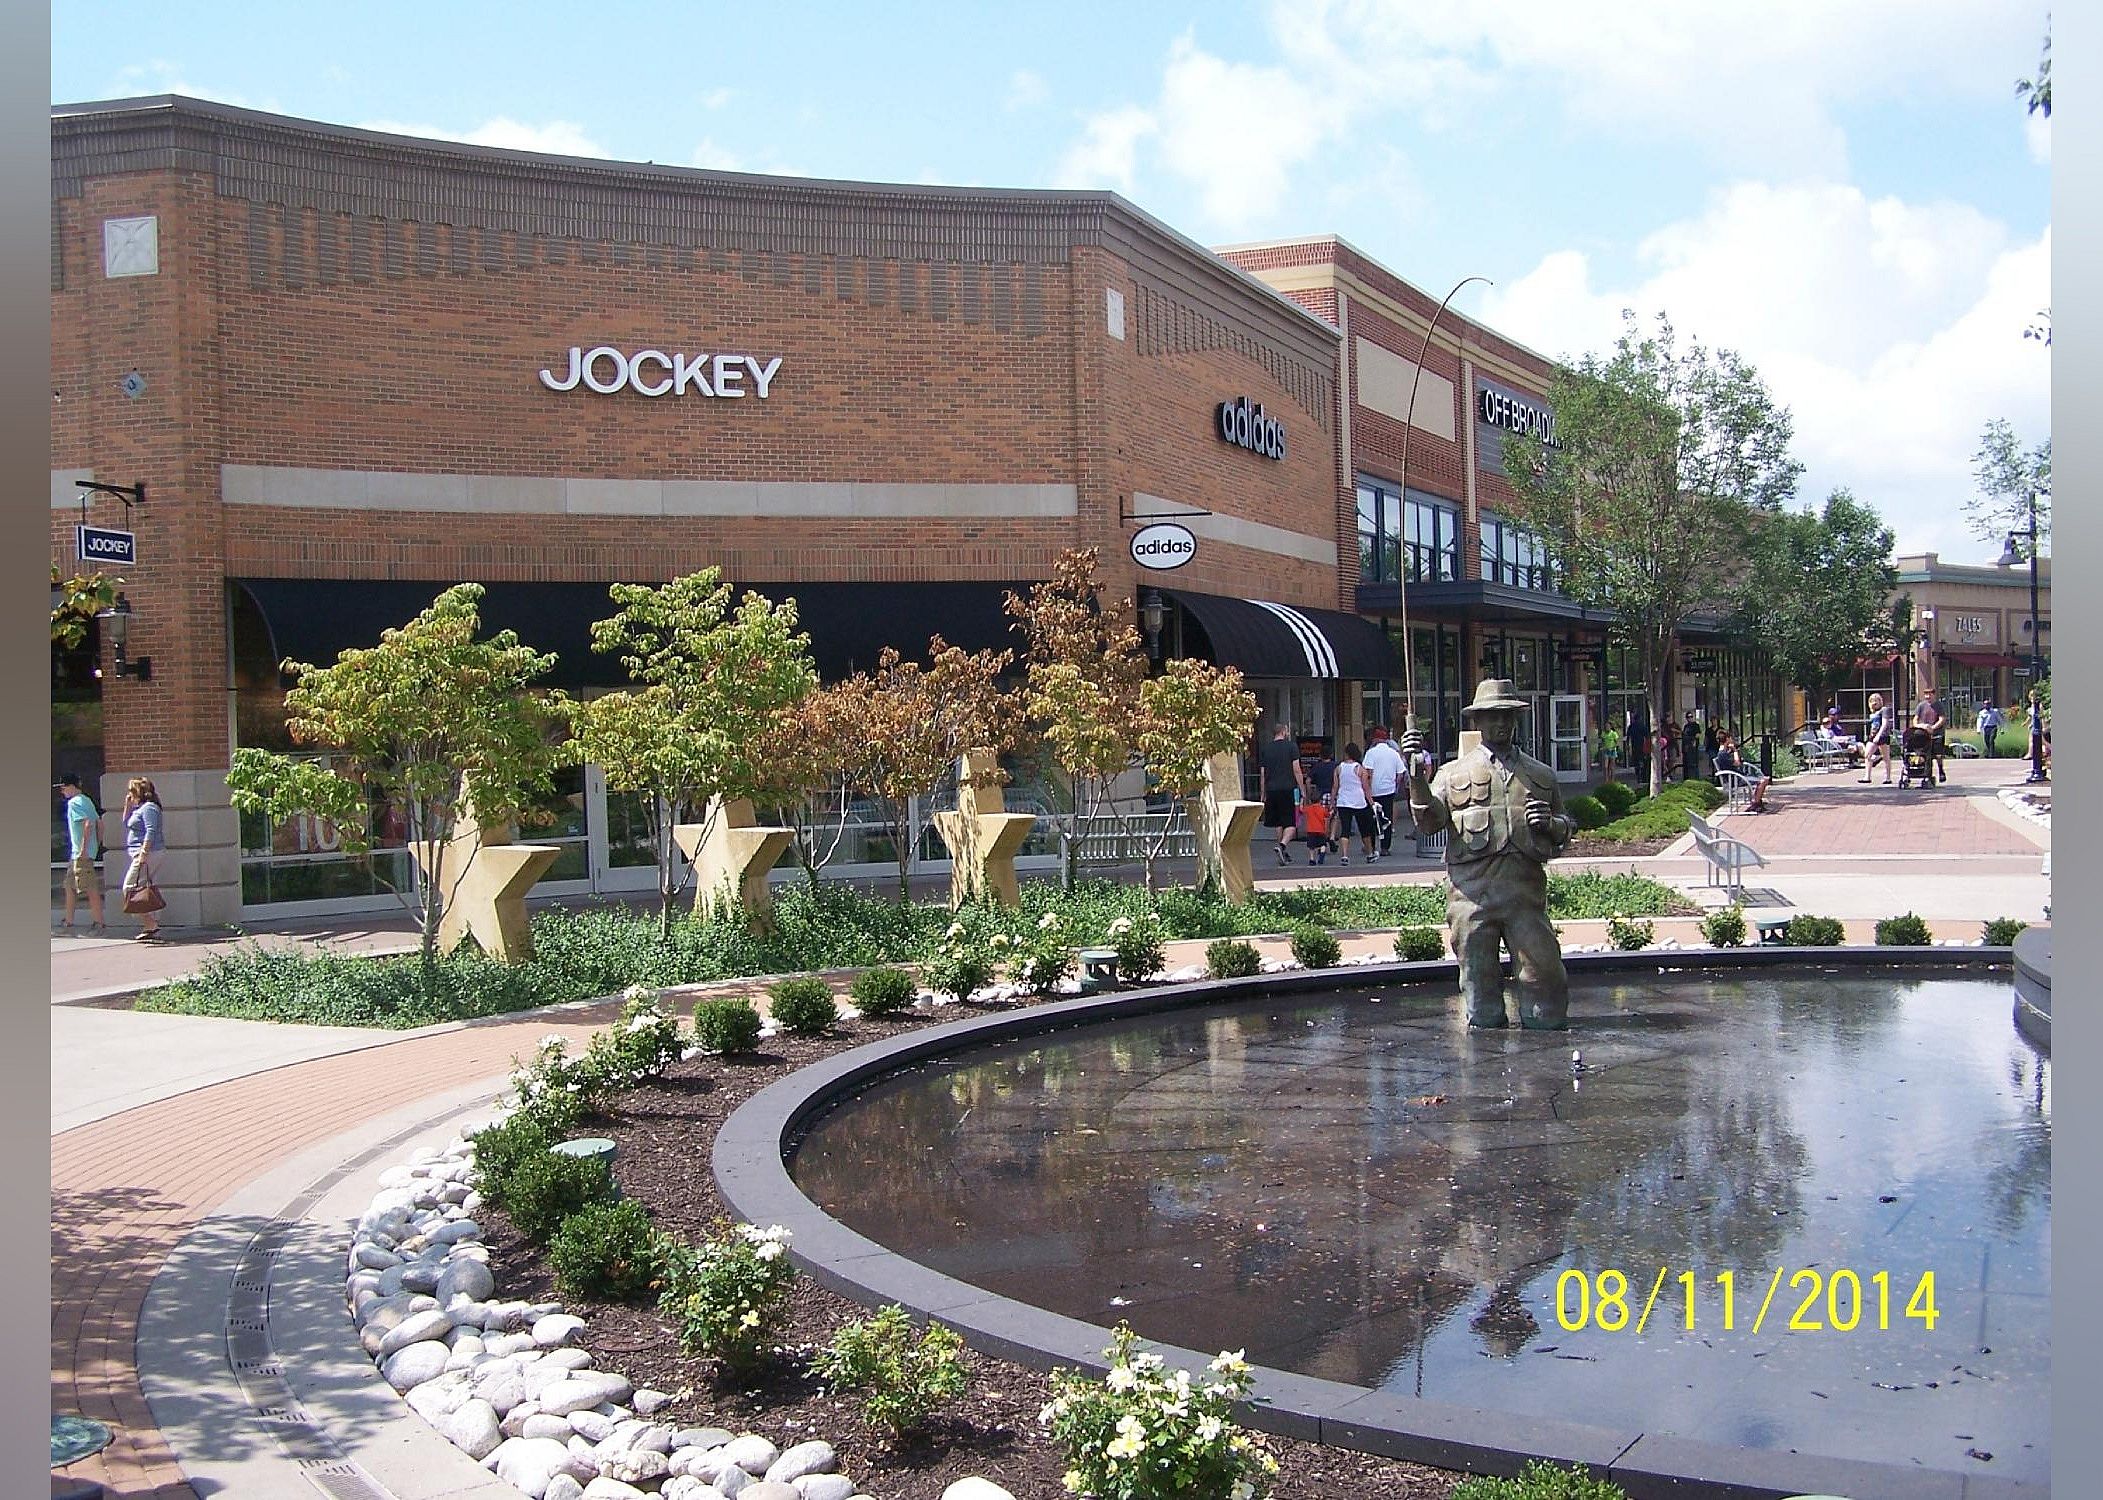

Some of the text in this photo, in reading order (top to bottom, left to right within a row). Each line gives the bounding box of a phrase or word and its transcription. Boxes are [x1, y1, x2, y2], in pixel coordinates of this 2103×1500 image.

[539, 346, 783, 399] JOCKEY
[1219, 396, 1286, 460] adidas
[1485, 389, 1510, 429] OFF
[88, 537, 131, 555] JOCKEY
[1135, 539, 1193, 556] adidas
